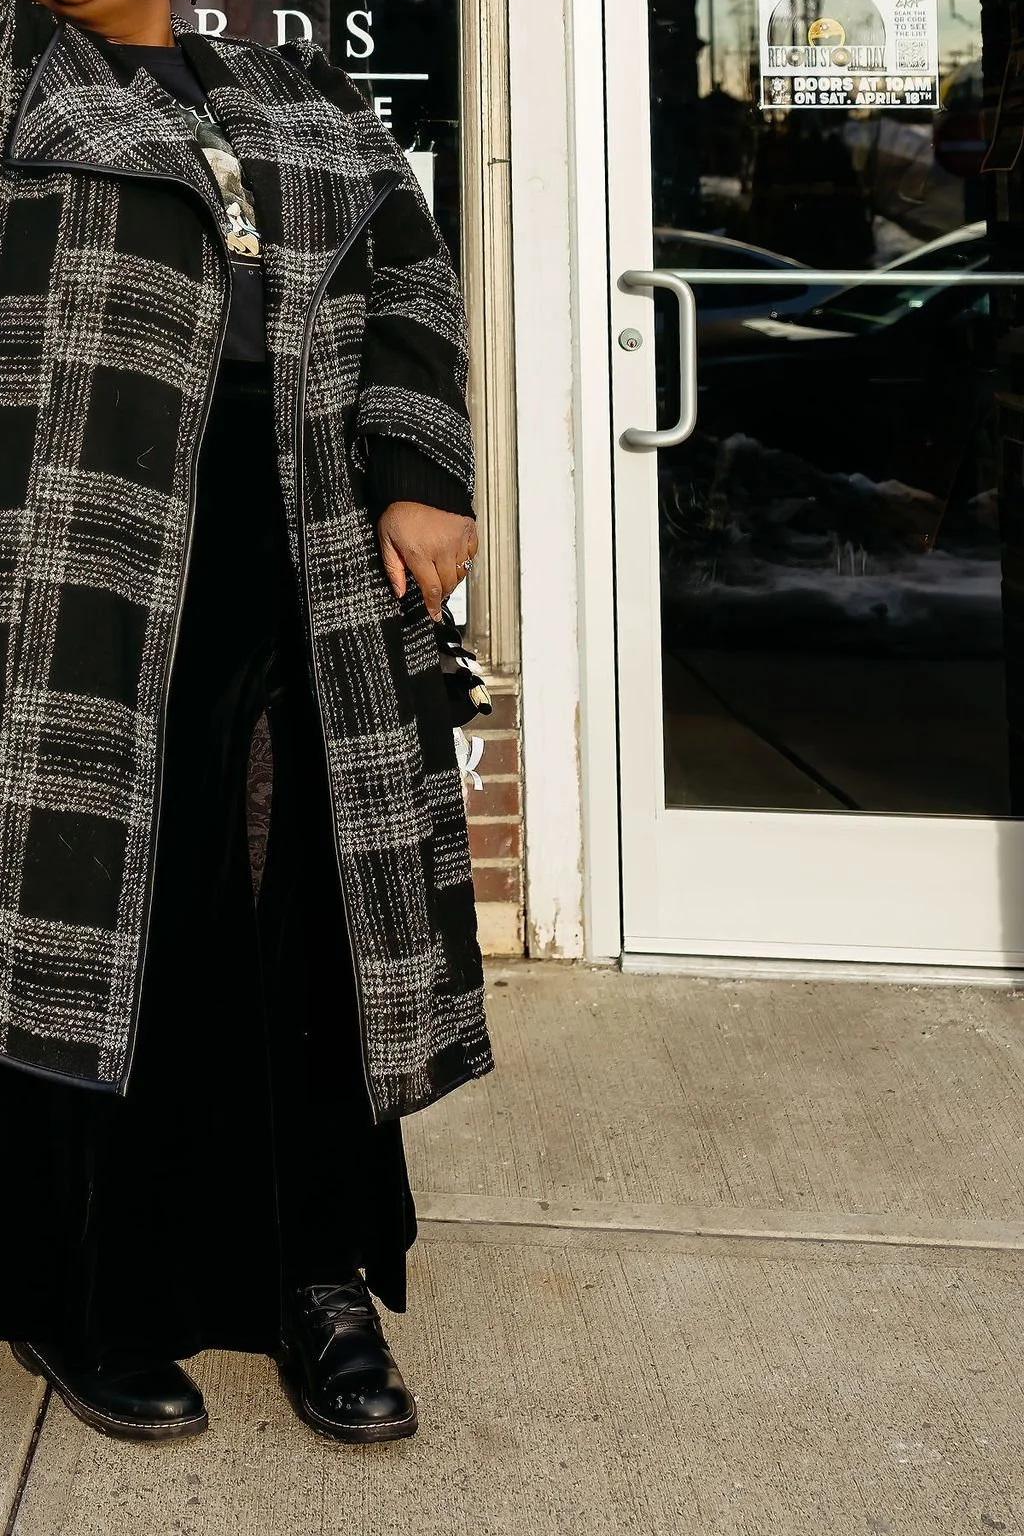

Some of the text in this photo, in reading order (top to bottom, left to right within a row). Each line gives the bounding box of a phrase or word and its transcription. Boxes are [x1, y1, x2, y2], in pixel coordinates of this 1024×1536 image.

[794, 77, 932, 92] DOORS AT 10AM
[794, 92, 817, 105] ON
[820, 92, 851, 105] SAT.
[856, 92, 900, 105] APRIL
